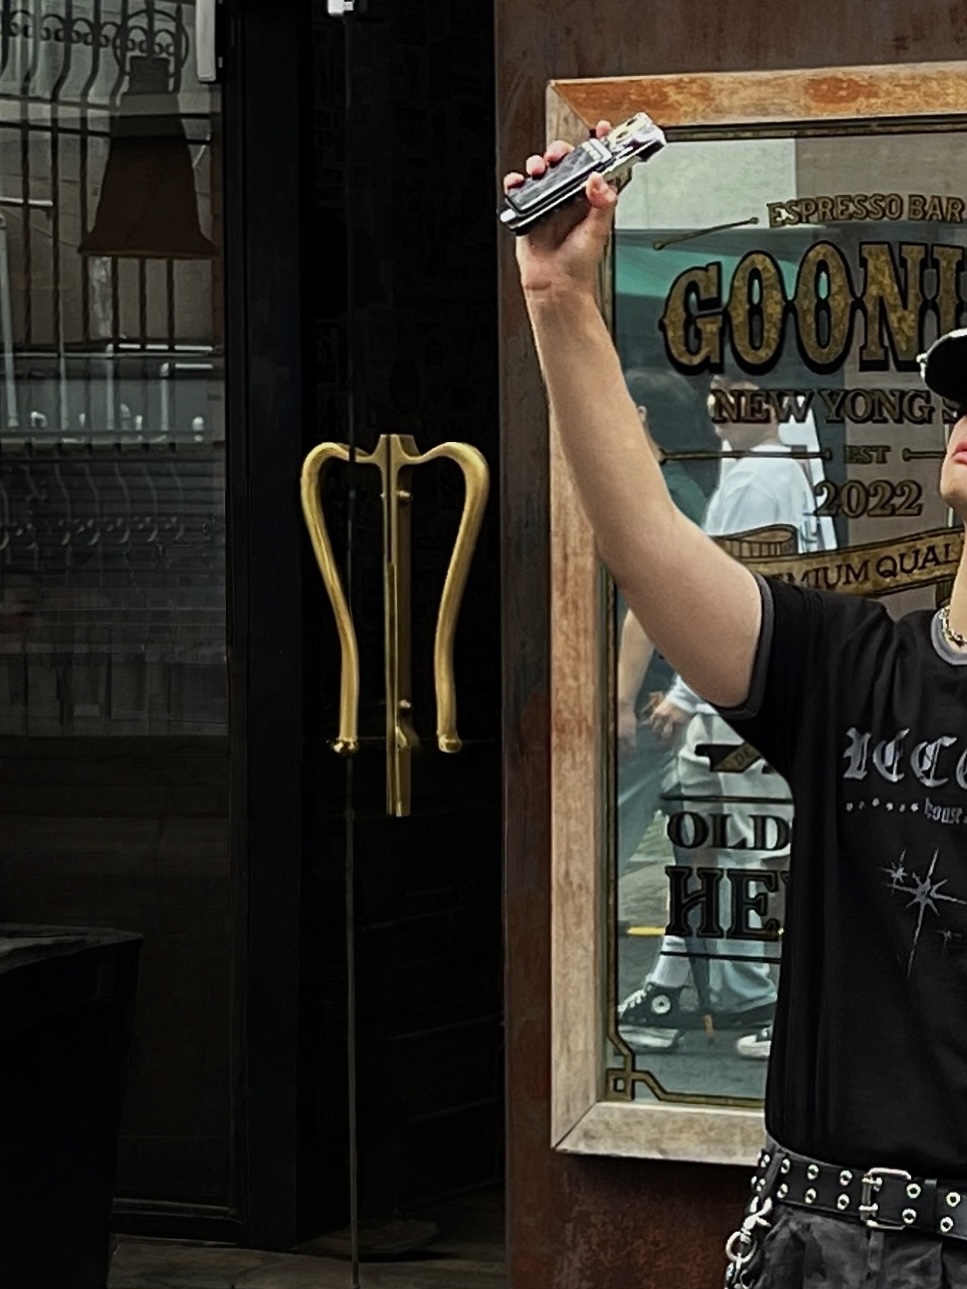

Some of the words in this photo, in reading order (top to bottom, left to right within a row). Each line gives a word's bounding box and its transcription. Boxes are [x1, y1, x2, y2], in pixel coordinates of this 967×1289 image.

[766, 193, 903, 228] ESPRESSO
[907, 194, 965, 223] BAR
[711, 389, 813, 424] NEW
[817, 389, 933, 424] YONG
[843, 445, 892, 464] EST
[813, 479, 924, 518] 2022
[876, 543, 963, 578] QUAL
[667, 811, 790, 850] OLD
[664, 866, 789, 941] HE
